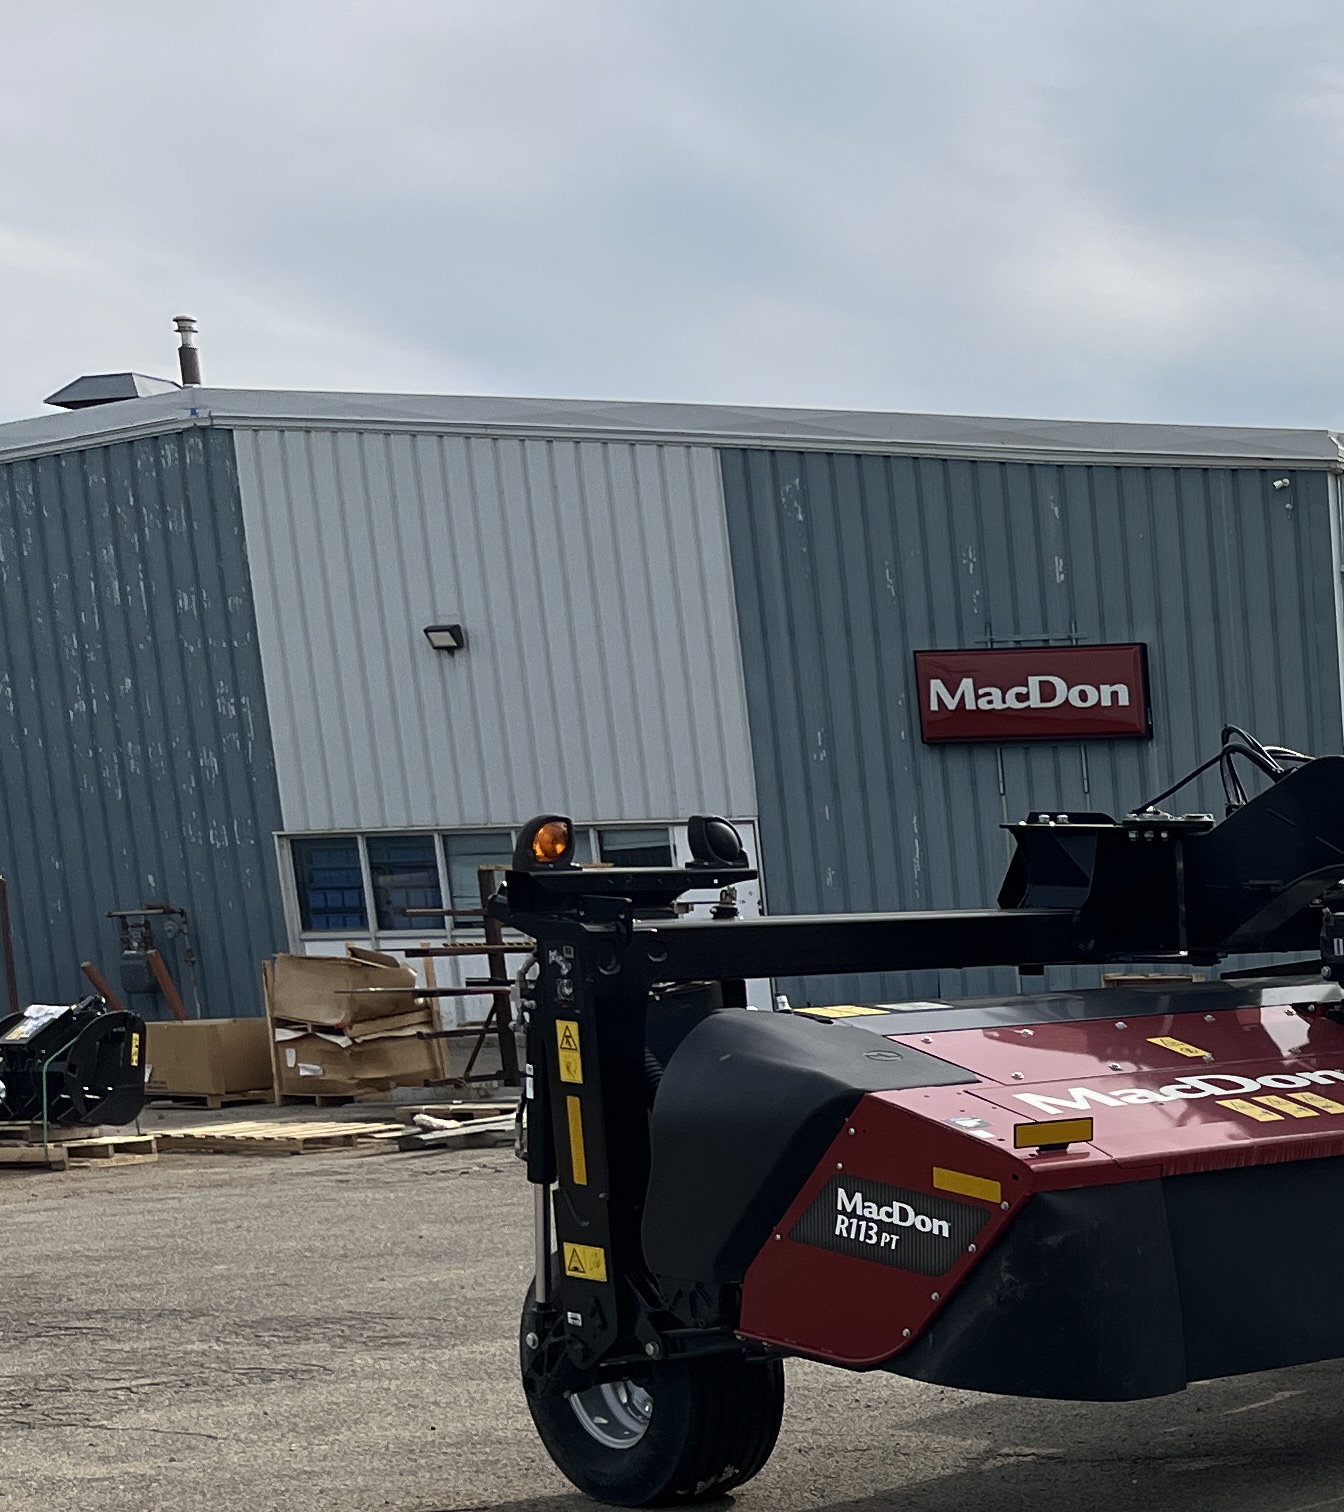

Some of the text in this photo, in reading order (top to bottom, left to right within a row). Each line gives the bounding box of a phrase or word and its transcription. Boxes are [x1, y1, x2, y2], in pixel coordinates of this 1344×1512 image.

[930, 676, 1130, 711] MacDon
[837, 1187, 950, 1238] MacDon
[834, 1214, 900, 1250] R113 PT
